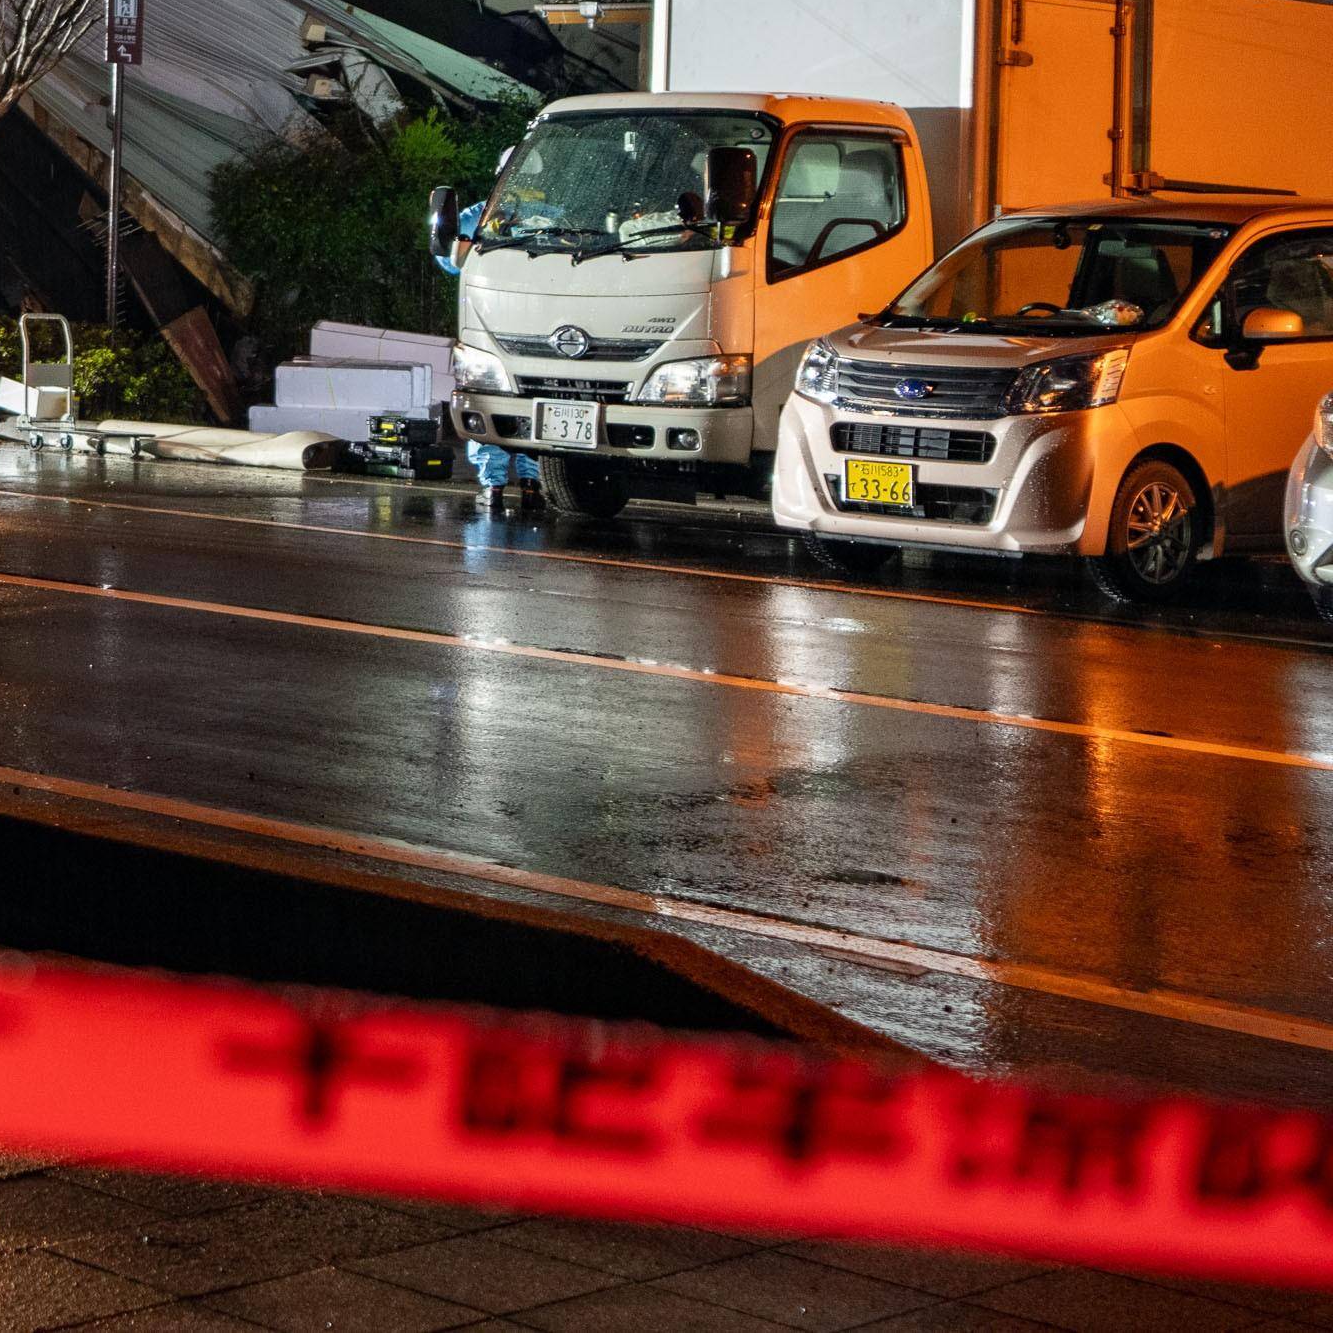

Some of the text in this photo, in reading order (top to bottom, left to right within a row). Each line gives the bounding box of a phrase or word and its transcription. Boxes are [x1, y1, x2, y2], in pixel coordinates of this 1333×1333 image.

[621, 325, 675, 334] DUTRO
[861, 463, 899, 477] 石川583
[860, 477, 911, 502] 33-66
